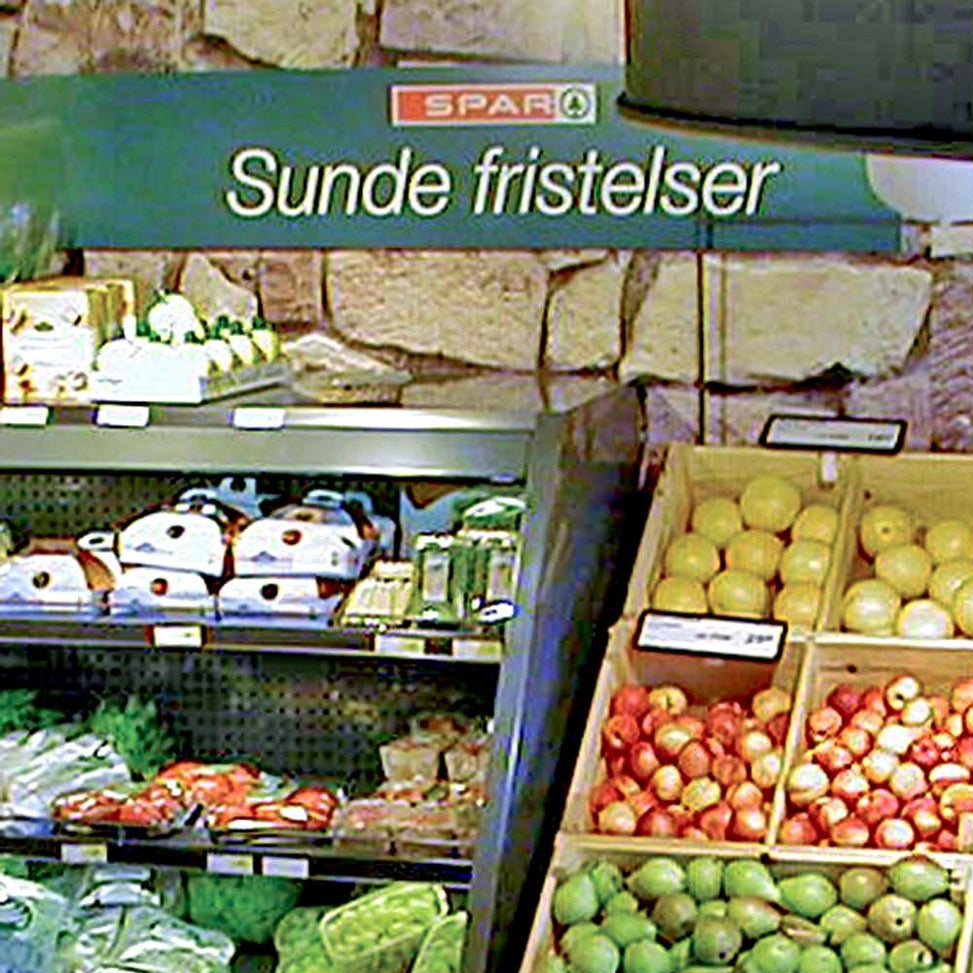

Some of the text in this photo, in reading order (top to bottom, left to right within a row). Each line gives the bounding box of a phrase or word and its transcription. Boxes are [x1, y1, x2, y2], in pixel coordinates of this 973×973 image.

[425, 93, 555, 117] SPAR
[227, 146, 780, 216] Sunde fristelser
